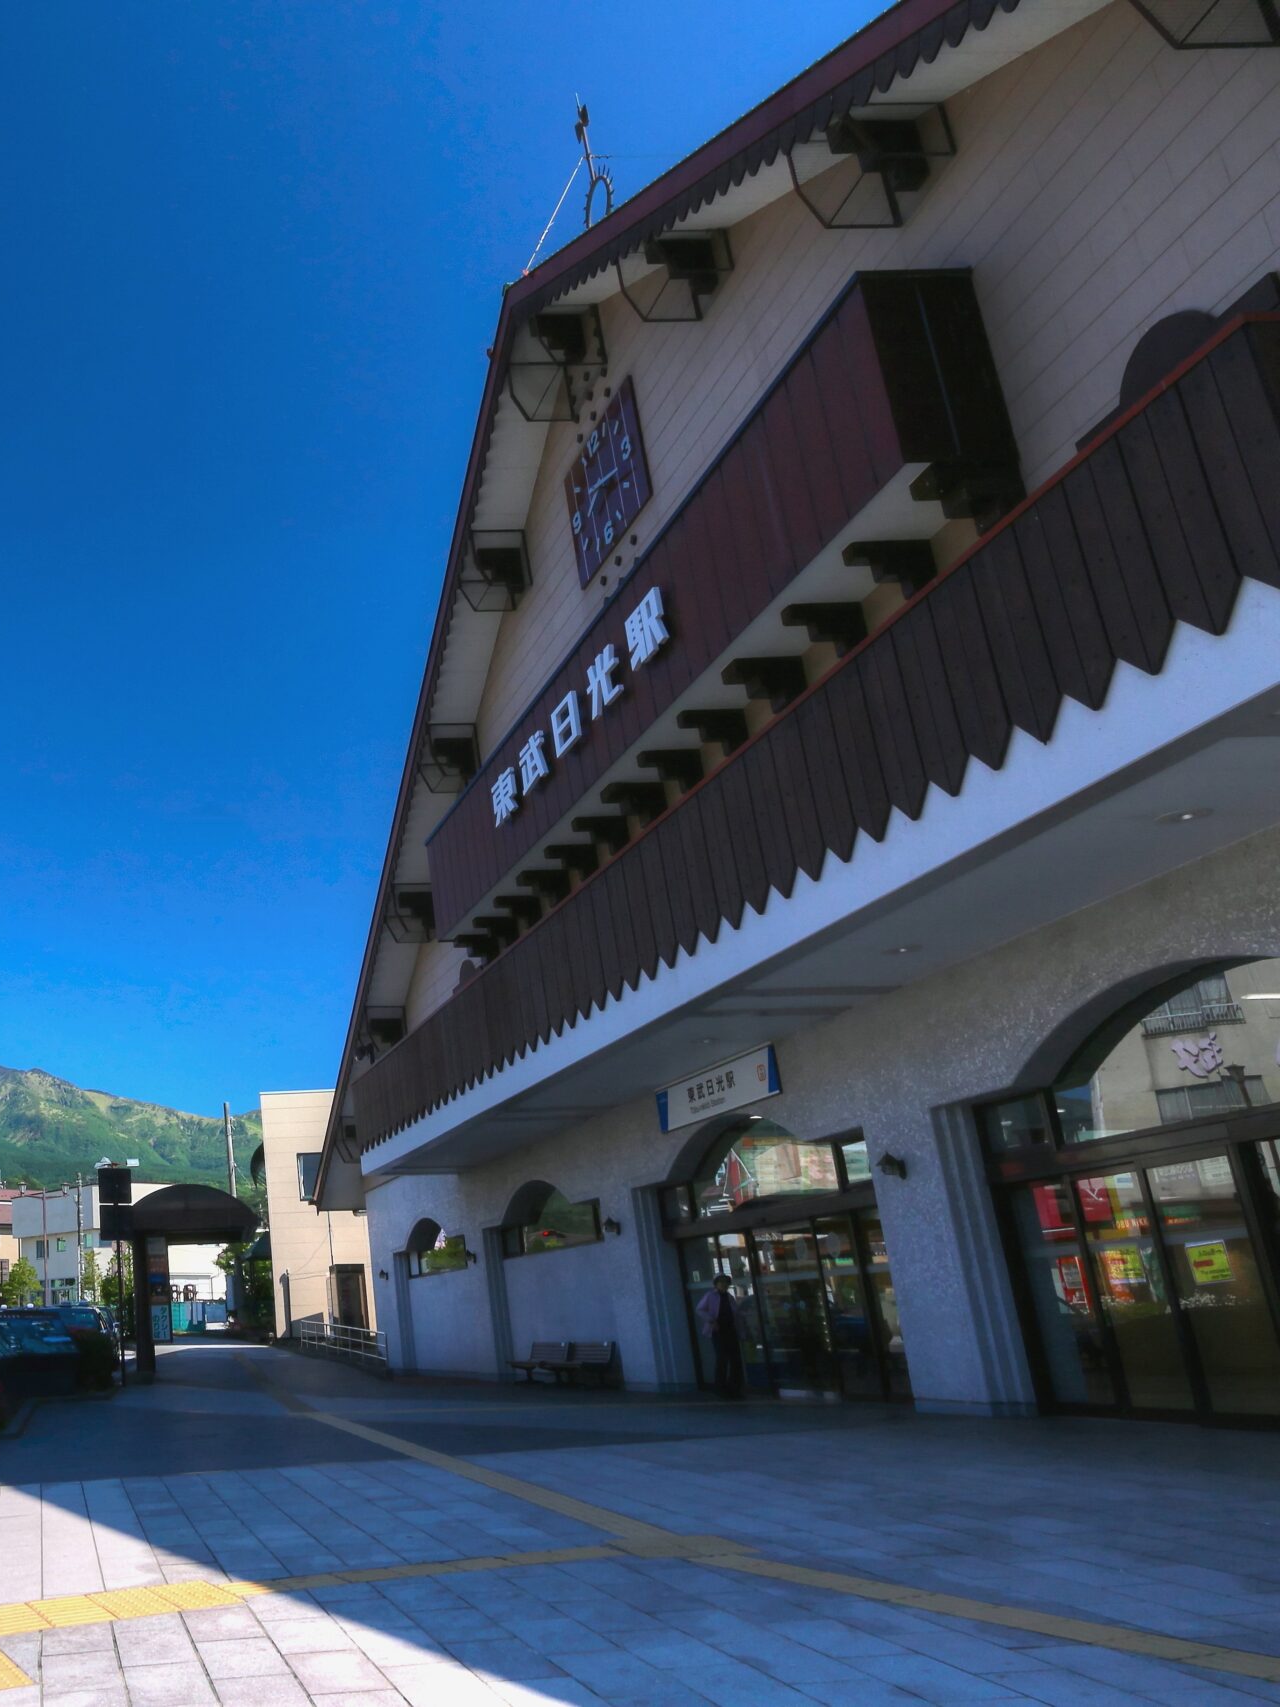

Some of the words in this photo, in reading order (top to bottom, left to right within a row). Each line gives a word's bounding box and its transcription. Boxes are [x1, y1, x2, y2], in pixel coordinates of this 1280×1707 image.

[587, 430, 601, 457] 12
[621, 436, 631, 460] 3
[572, 511, 582, 535] 9
[603, 520, 614, 545] 6
[490, 586, 670, 829] 東武日光駅
[686, 1070, 736, 1103] 東武日光駅
